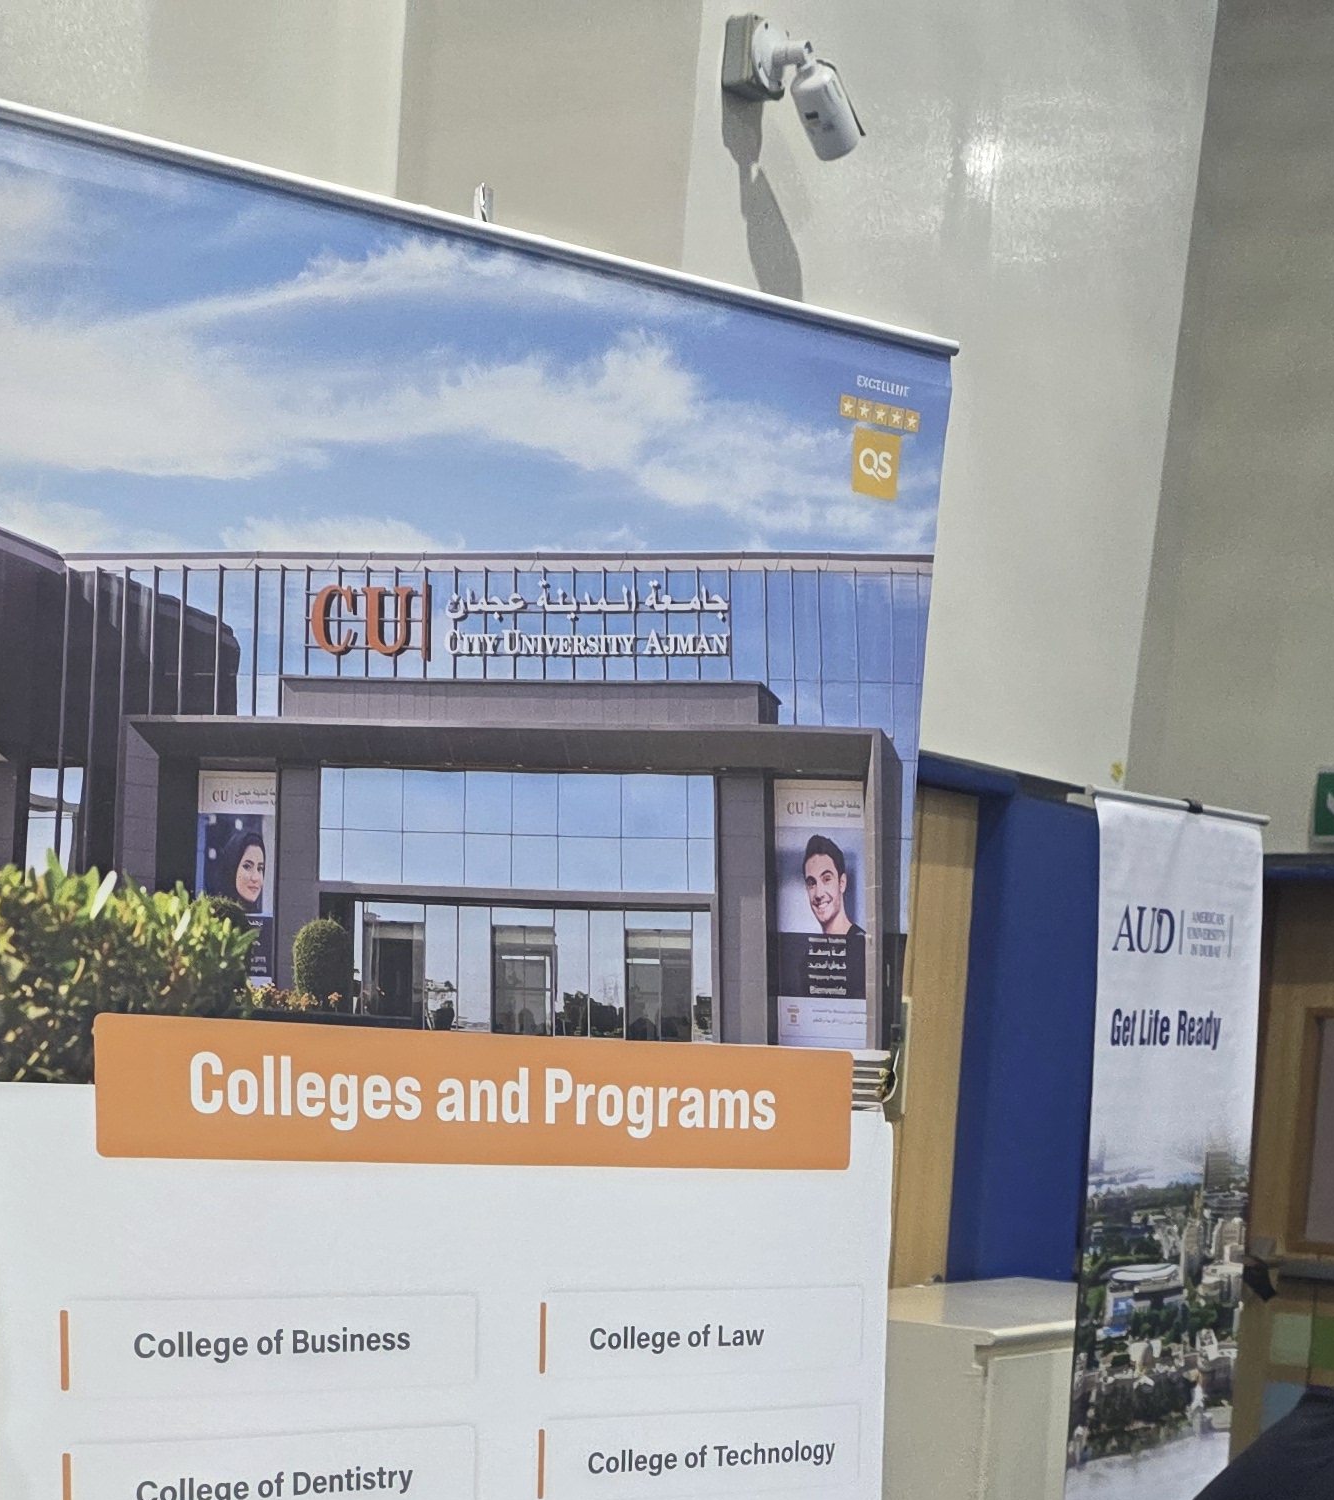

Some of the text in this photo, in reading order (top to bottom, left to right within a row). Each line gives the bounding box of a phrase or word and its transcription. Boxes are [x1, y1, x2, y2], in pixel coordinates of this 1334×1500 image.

[858, 447, 892, 483] QS
[444, 578, 730, 621] جامعة المدينة عجمان
[310, 584, 412, 656] CU
[1112, 904, 1175, 954] AUD
[1110, 1008, 1222, 1051] Get Life Ready
[190, 1051, 777, 1139] Colleges and Programs
[133, 1326, 411, 1364] College of Business
[589, 1323, 765, 1355] College of Law
[588, 1439, 836, 1476] College of Technology
[257, 1471, 285, 1499] of
[293, 1465, 413, 1495] Dentistry
